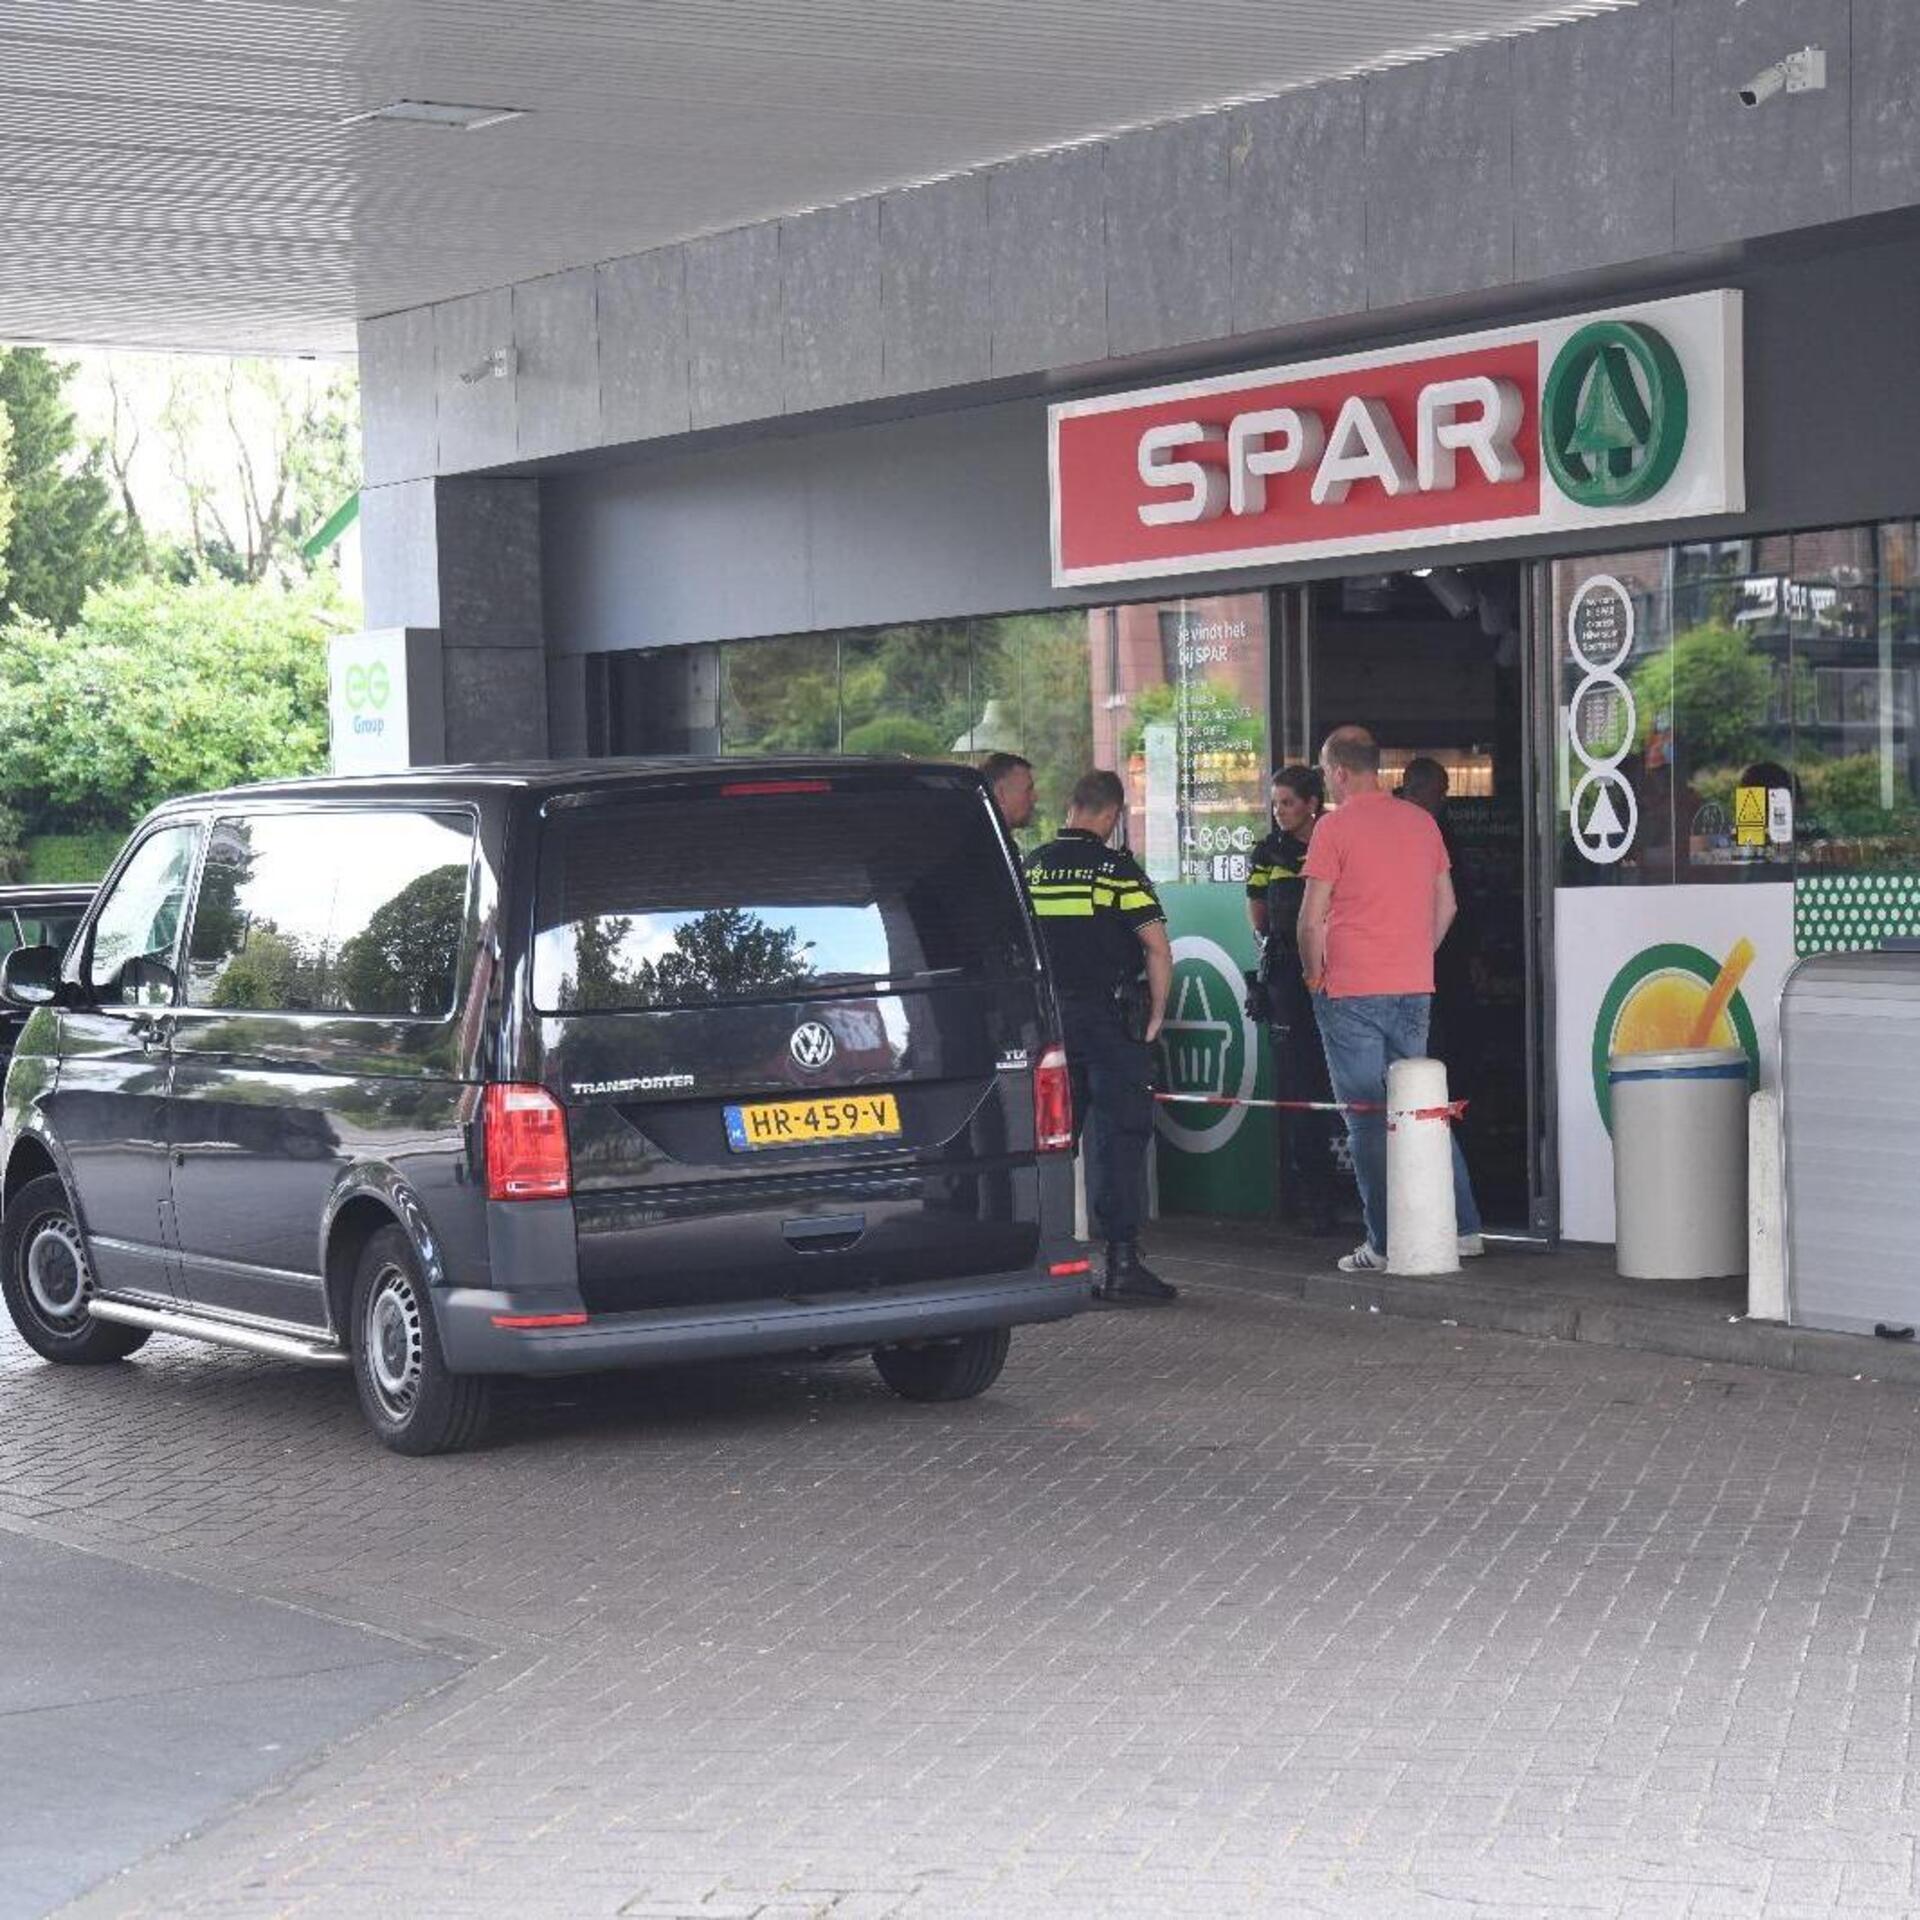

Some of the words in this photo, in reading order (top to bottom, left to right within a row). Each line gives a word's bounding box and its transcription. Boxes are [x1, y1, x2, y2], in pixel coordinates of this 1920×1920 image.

[1138, 376, 1518, 526] SPAR
[1224, 621, 1246, 638] het
[1196, 646, 1228, 663] SPAR
[352, 714, 385, 737] Group
[571, 1074, 695, 1095] TRANSPORTER
[751, 1100, 886, 1137] HR-459-V
